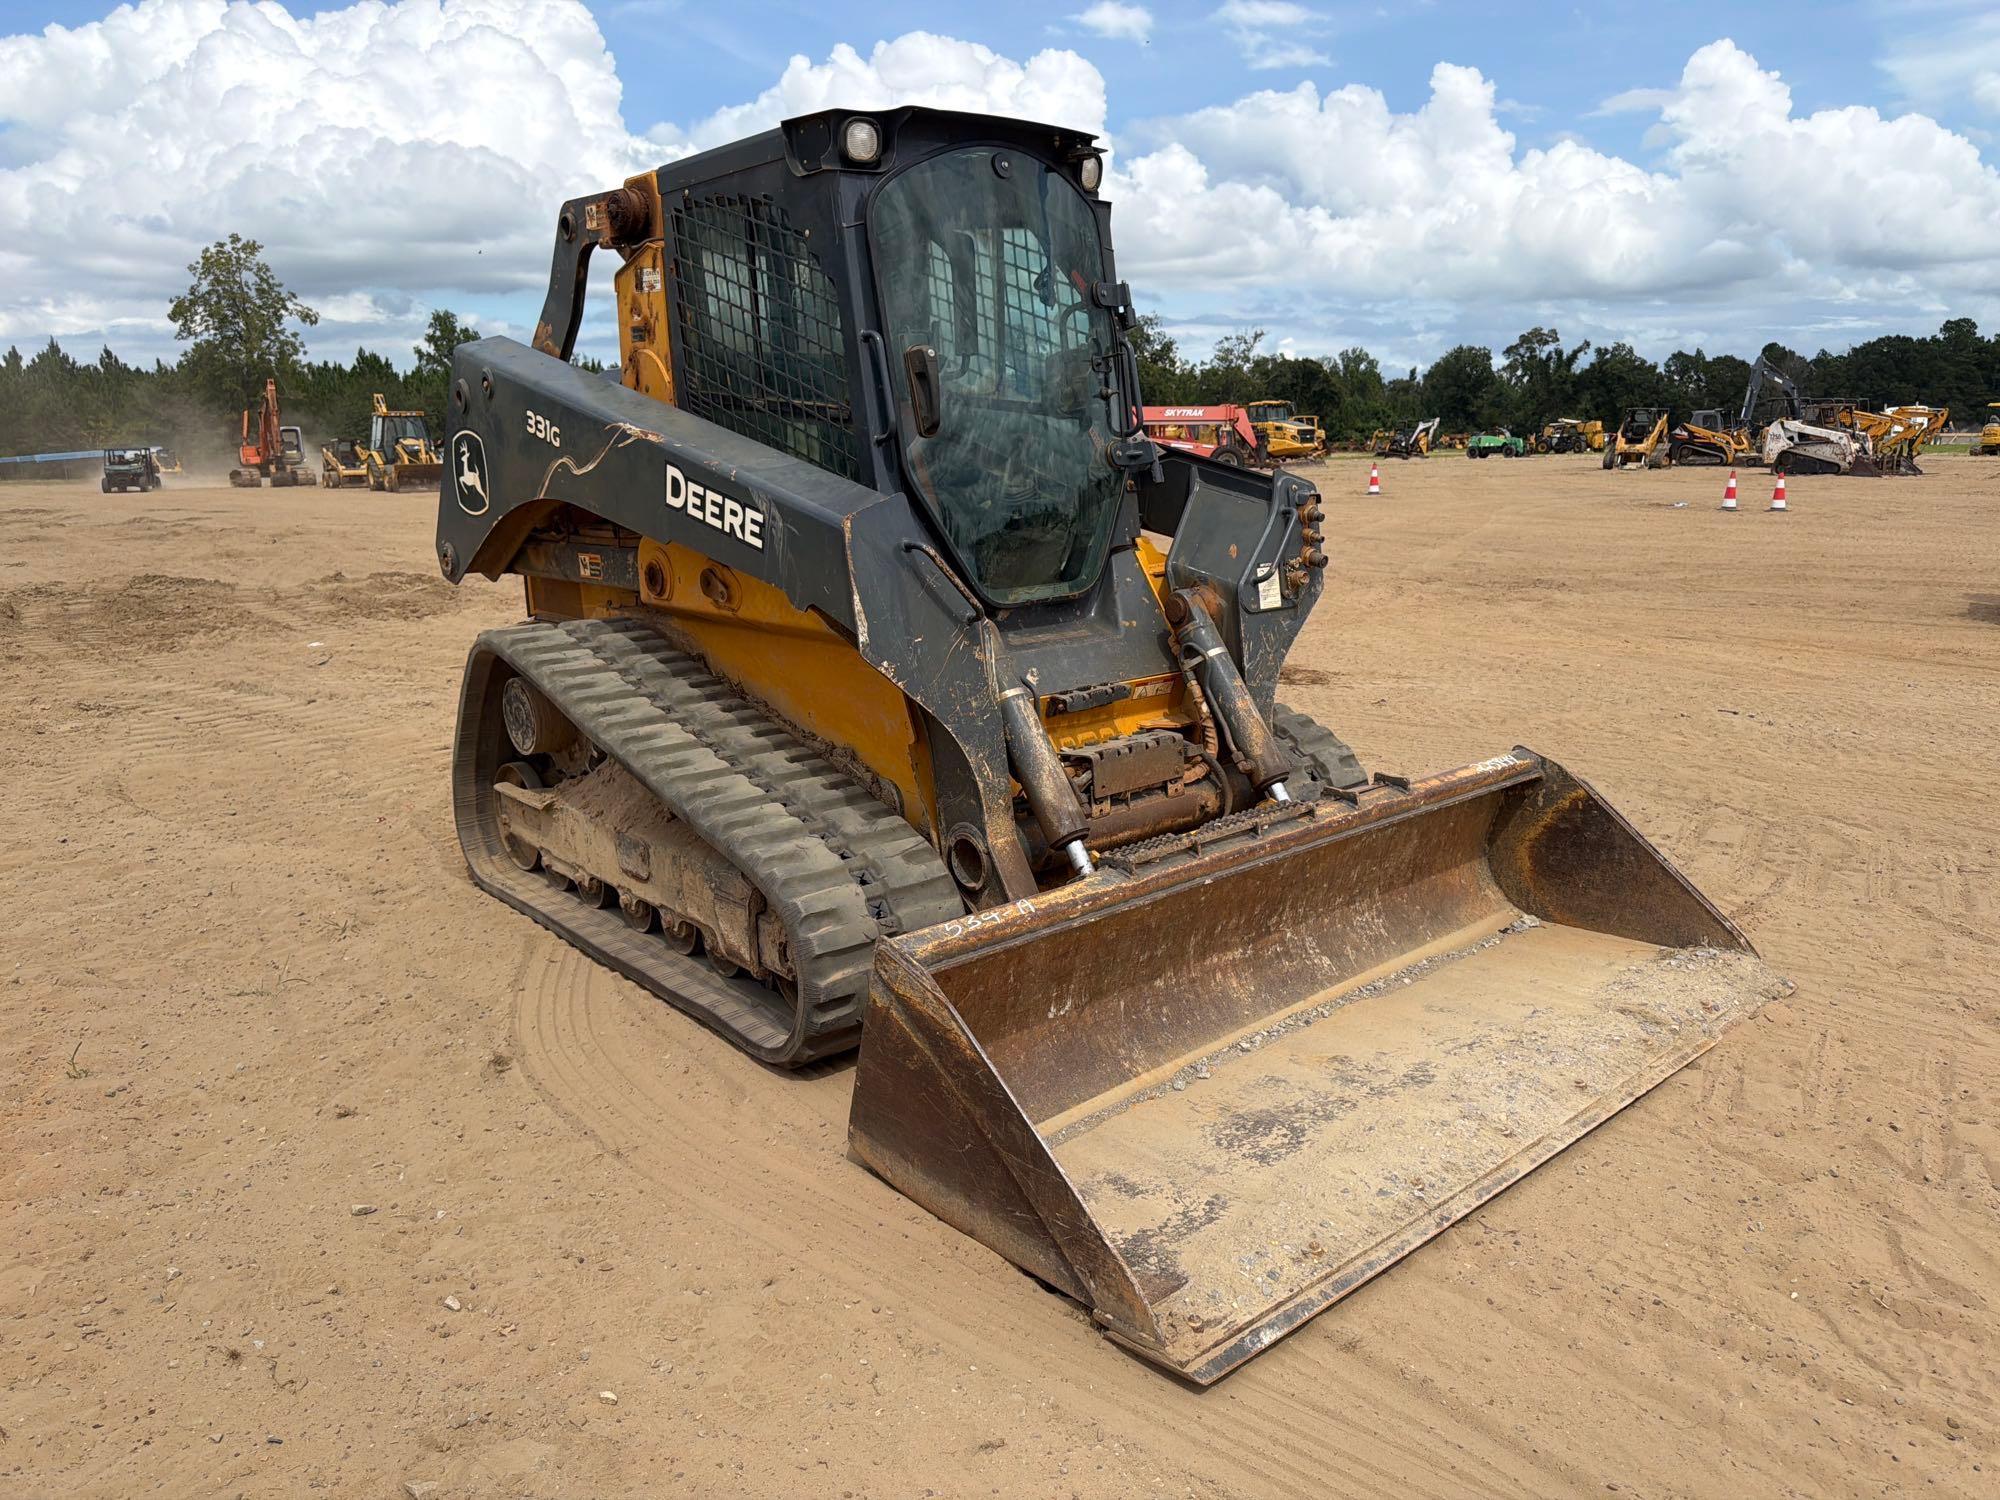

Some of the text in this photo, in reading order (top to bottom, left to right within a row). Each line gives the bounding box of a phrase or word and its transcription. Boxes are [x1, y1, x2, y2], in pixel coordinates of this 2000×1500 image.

[526, 410, 560, 448] 331G
[1164, 408, 1204, 417] SKYTRAK
[666, 463, 764, 549] DEERE
